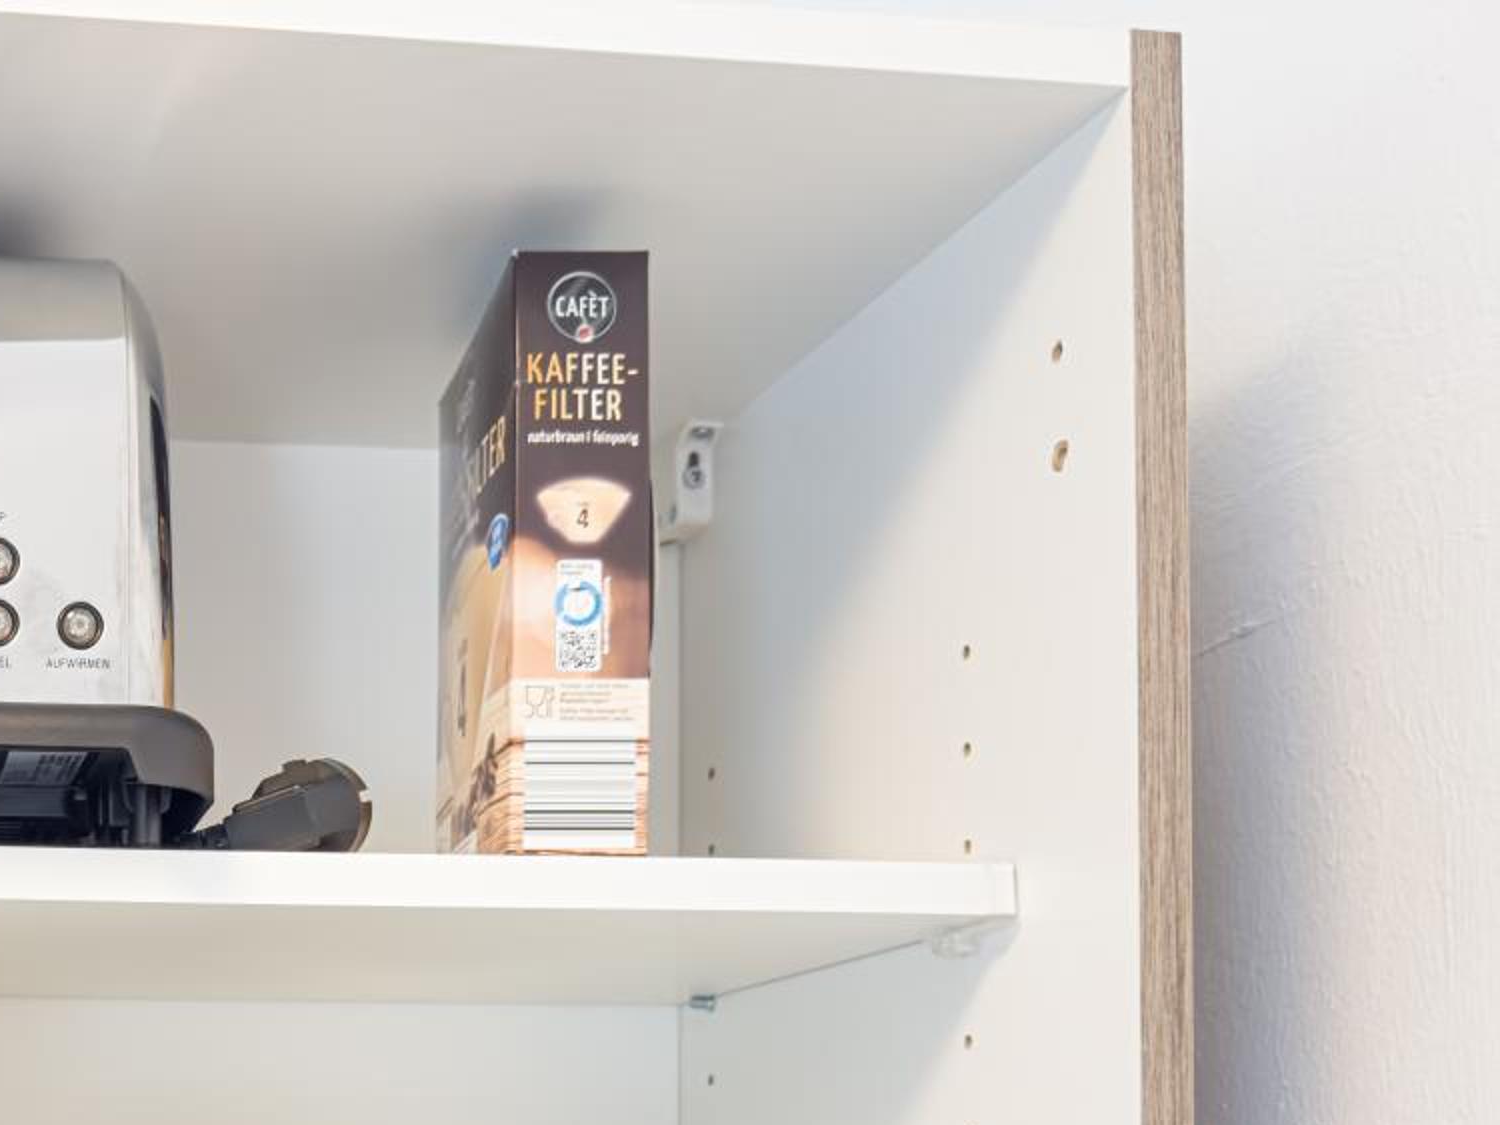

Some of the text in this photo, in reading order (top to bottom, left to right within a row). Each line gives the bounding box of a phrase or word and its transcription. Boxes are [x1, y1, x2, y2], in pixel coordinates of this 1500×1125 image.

[555, 290, 609, 319] CAFÈT
[526, 352, 638, 384] KAFFEE-
[534, 388, 622, 421] FILTER
[527, 429, 586, 444] naturbraun
[576, 508, 589, 529] 4
